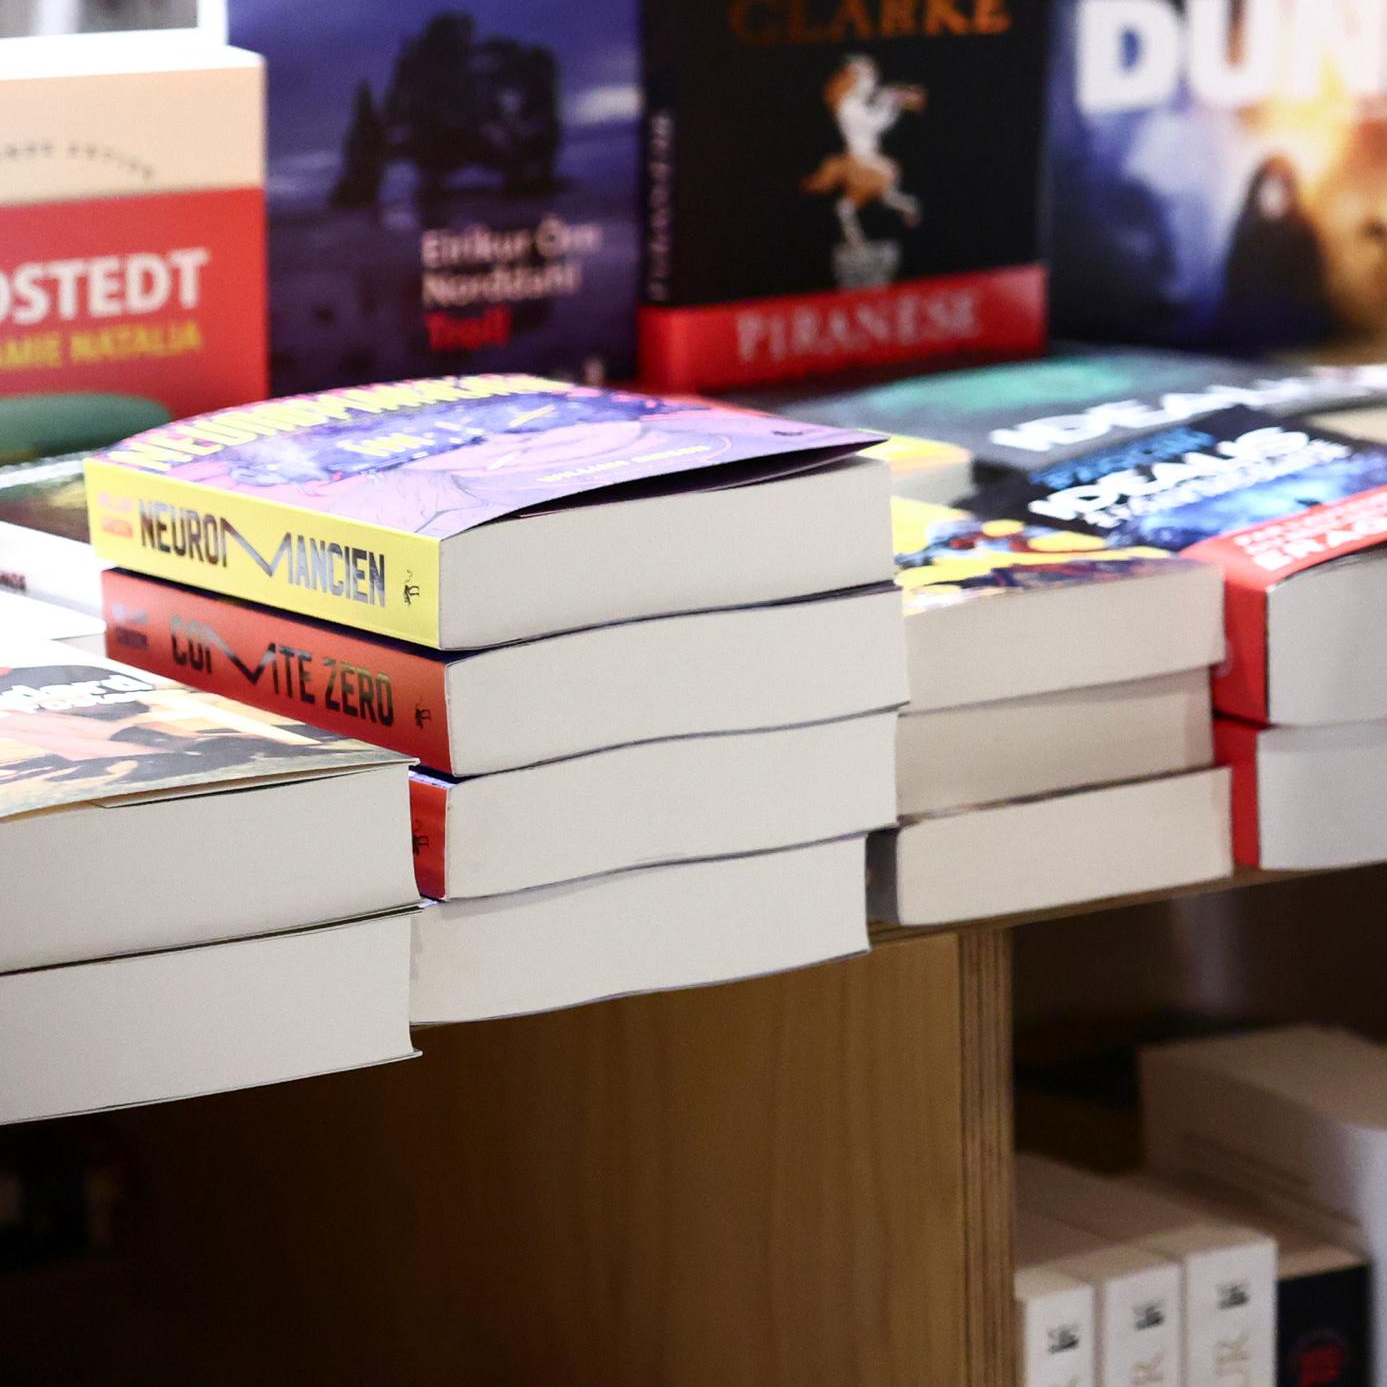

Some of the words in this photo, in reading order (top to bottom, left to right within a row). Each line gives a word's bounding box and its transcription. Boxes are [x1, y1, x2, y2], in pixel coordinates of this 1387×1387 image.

[0, 246, 209, 326] STEDT
[139, 499, 386, 607] NEUROMANCIEN
[325, 661, 394, 726] ZERO
